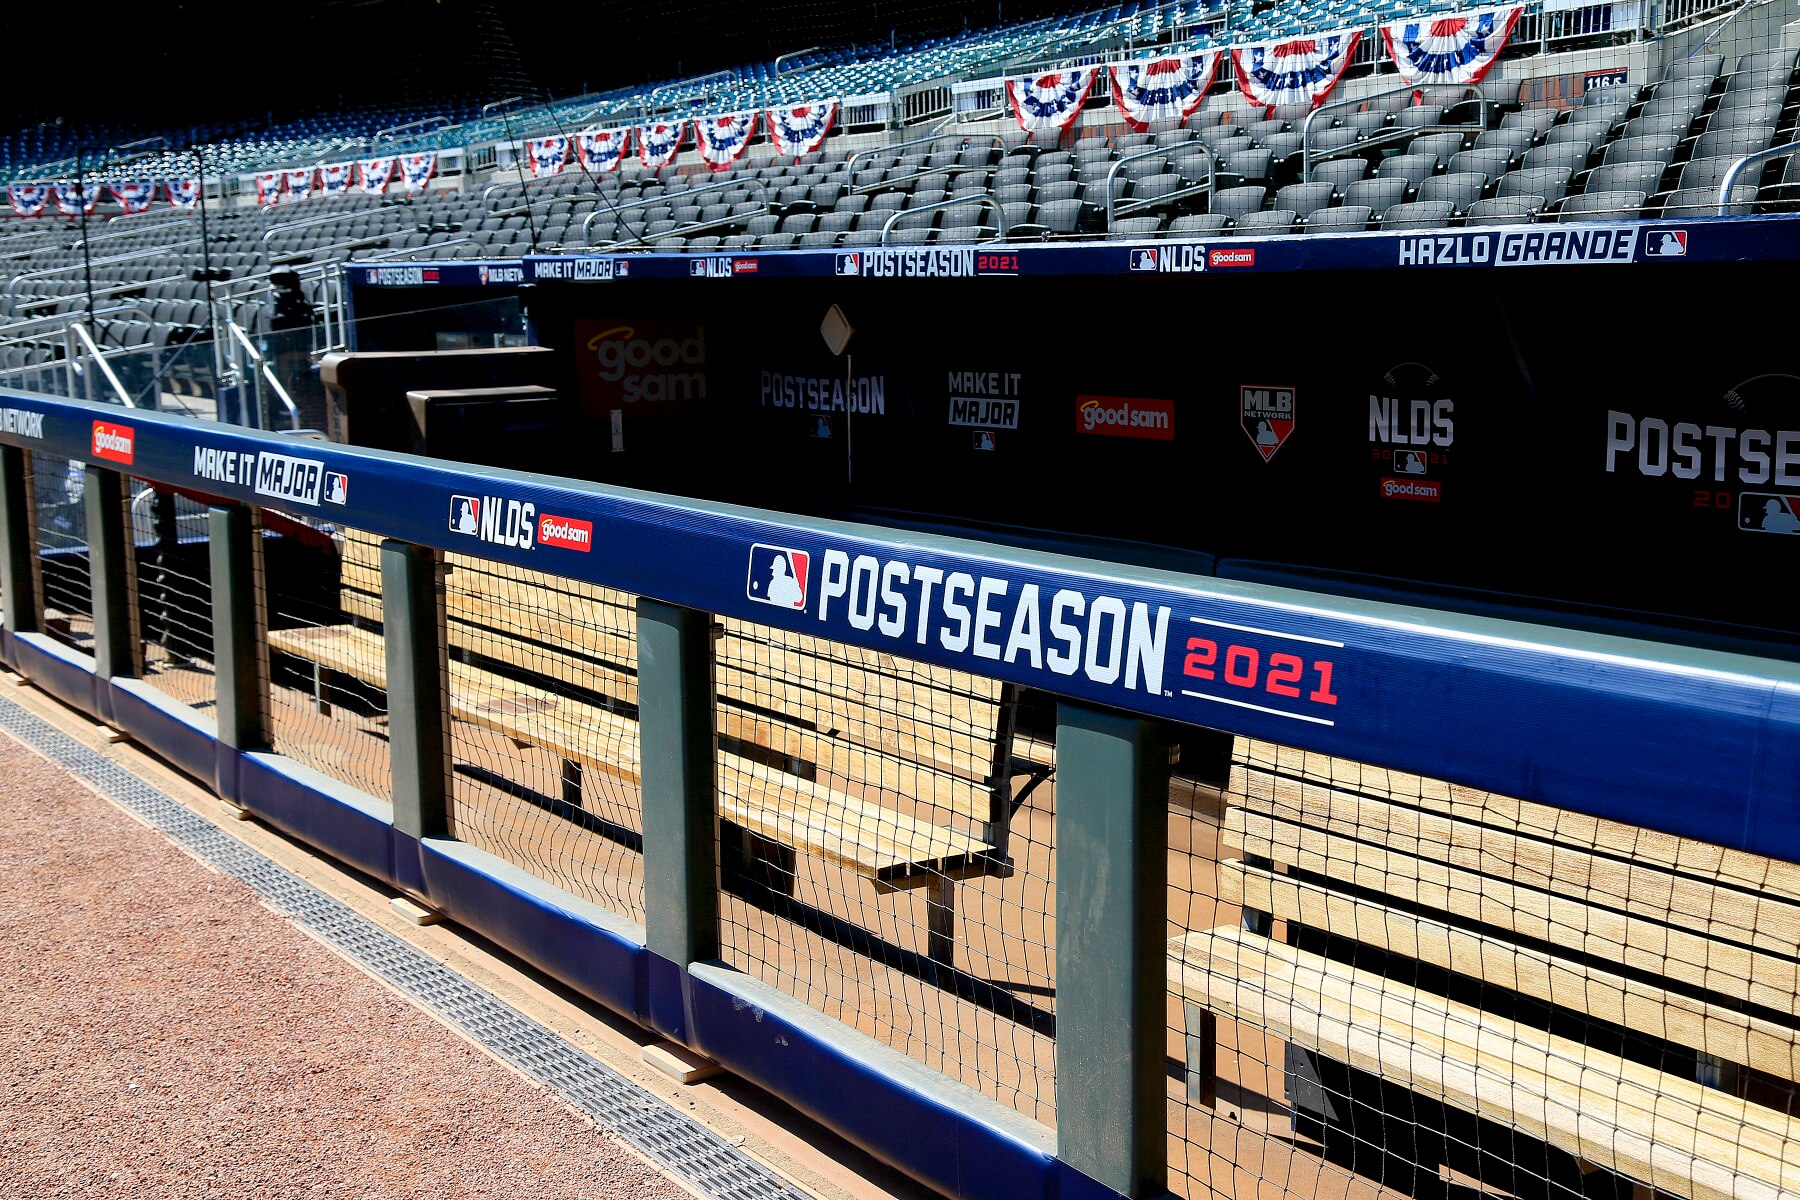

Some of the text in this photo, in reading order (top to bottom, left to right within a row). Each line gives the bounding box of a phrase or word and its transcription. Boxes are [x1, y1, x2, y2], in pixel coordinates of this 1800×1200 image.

[1159, 245, 1205, 273] NLDS
[1399, 229, 1633, 265] HAZLO GRANDE
[377, 267, 423, 285] POSTSEASON
[535, 259, 611, 278] MAKE IT MAJOR
[706, 257, 732, 278] NLDS
[863, 250, 1019, 277] POSTSEASON 2021
[596, 326, 707, 382] good
[622, 372, 707, 404] sam
[760, 370, 886, 416] POSTSEASON
[948, 371, 1022, 395] MAKE IT
[951, 400, 1016, 426] MAJOR
[1243, 411, 1292, 419] NETWORK
[1244, 390, 1292, 411] MLB
[3, 407, 45, 440] NETWORK
[1368, 395, 1455, 447] NLDS
[1605, 409, 1800, 487] POSTSE
[194, 446, 317, 501] MAKE IT MAJOR
[1693, 490, 1731, 509] 20
[480, 495, 535, 550] NLDS
[818, 548, 1338, 705] POSTSEASON 2021
